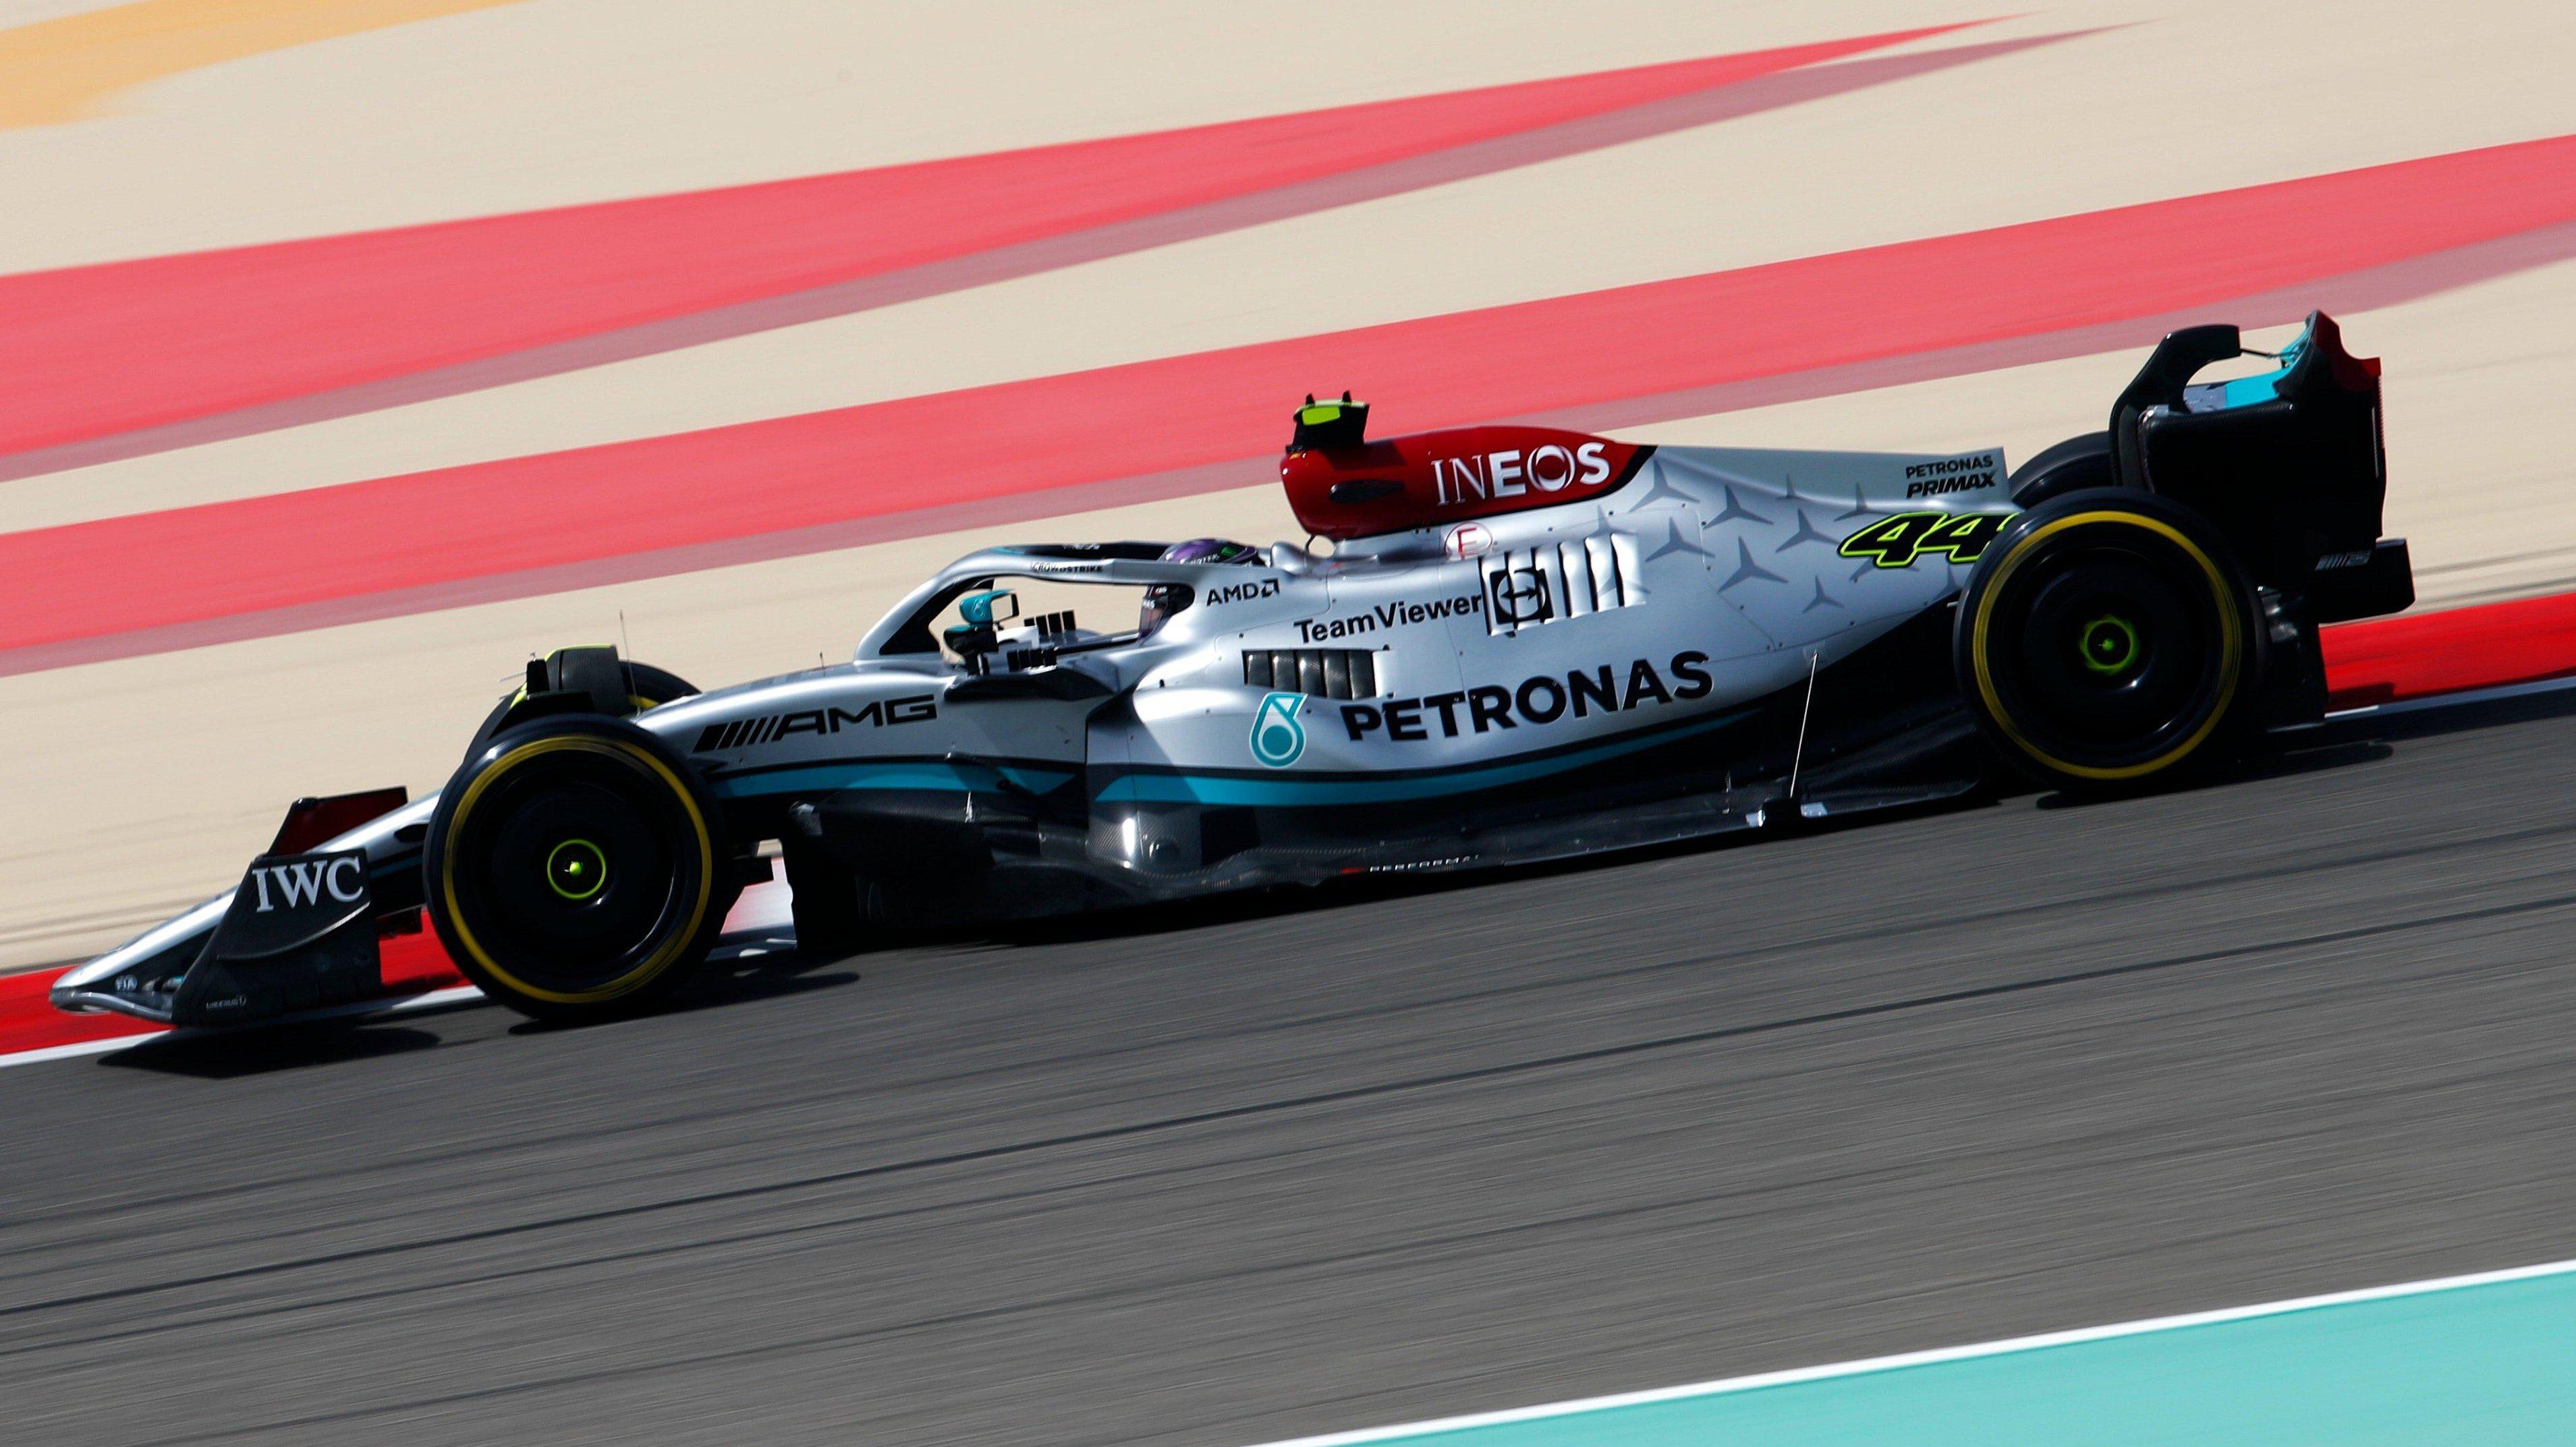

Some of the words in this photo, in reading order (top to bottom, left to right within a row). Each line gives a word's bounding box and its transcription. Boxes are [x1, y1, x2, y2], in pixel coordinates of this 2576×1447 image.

[1431, 442, 1611, 505] INEOS
[1905, 455, 1993, 478] PETRONAS
[1906, 470, 1996, 499] PRIMAX
[1457, 527, 1478, 561] F
[1837, 511, 2019, 568] 44
[1206, 582, 1259, 607] AMD
[1294, 592, 1484, 644] TeamViewer
[771, 693, 937, 741] AMG
[1339, 650, 1714, 741] PETRONAS
[251, 855, 364, 913] IWC
